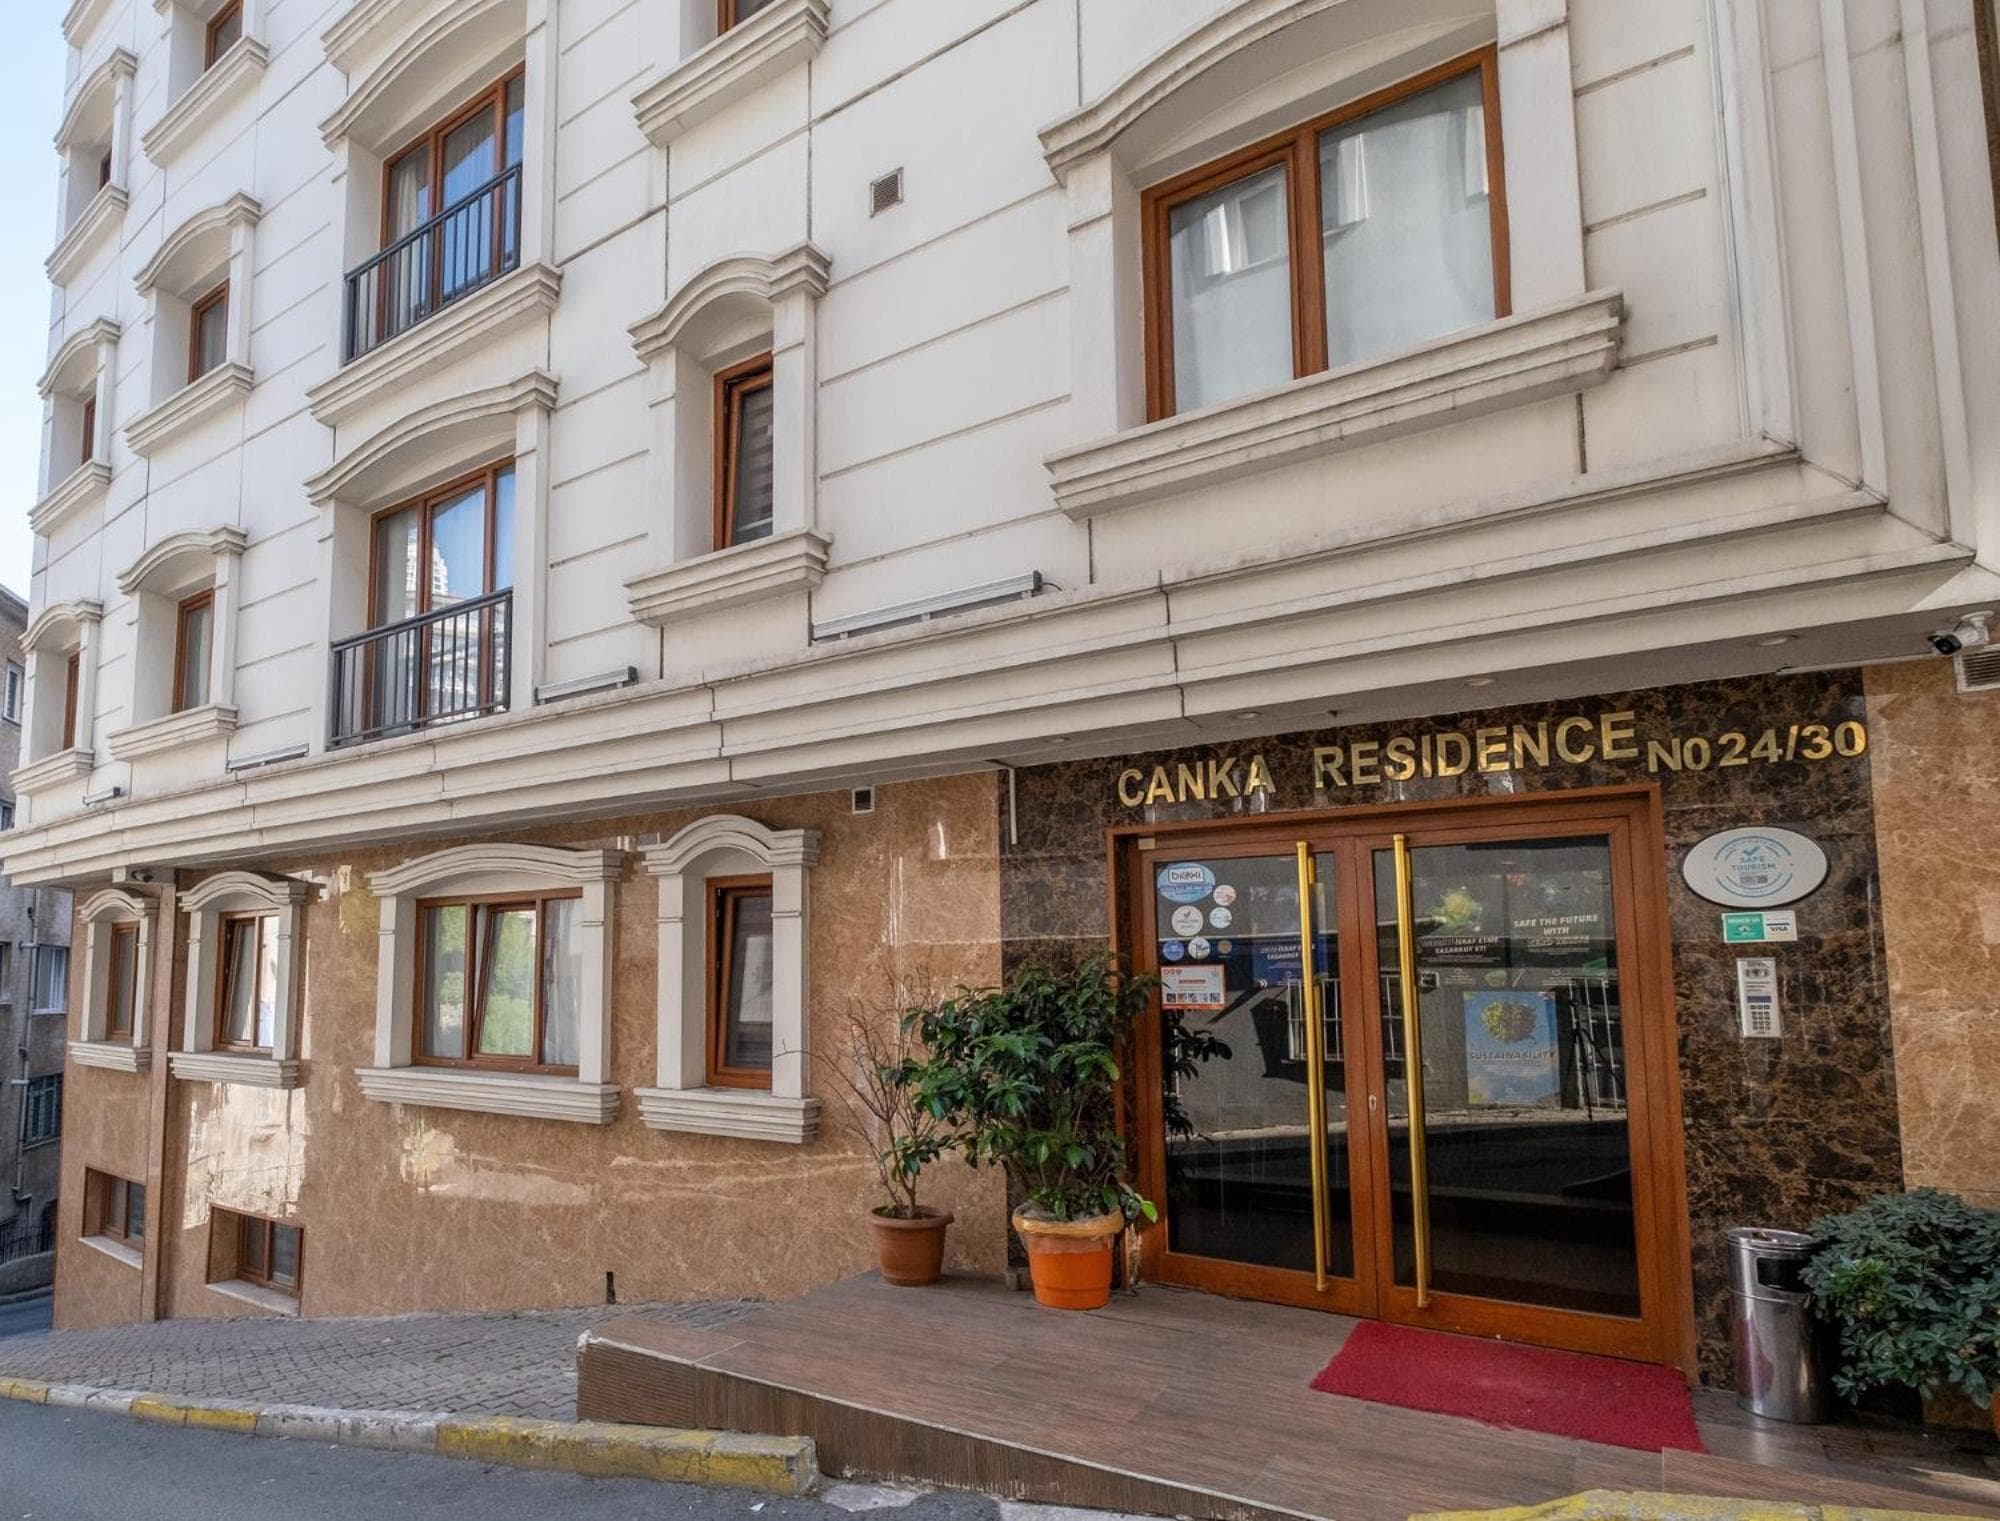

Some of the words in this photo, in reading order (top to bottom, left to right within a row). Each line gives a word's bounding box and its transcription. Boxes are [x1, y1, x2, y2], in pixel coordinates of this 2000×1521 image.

[1718, 720, 1867, 768] 24/30
[1118, 755, 1277, 807] CANKA
[1314, 711, 1638, 789] RESIDENCE
[1731, 863, 1776, 871] TOURISM
[1539, 917, 1559, 926] THE
[1560, 914, 1599, 924] FUTURE
[1543, 927, 1570, 936] WITH
[1469, 1049, 1556, 1061] SUSTAINABILITY
